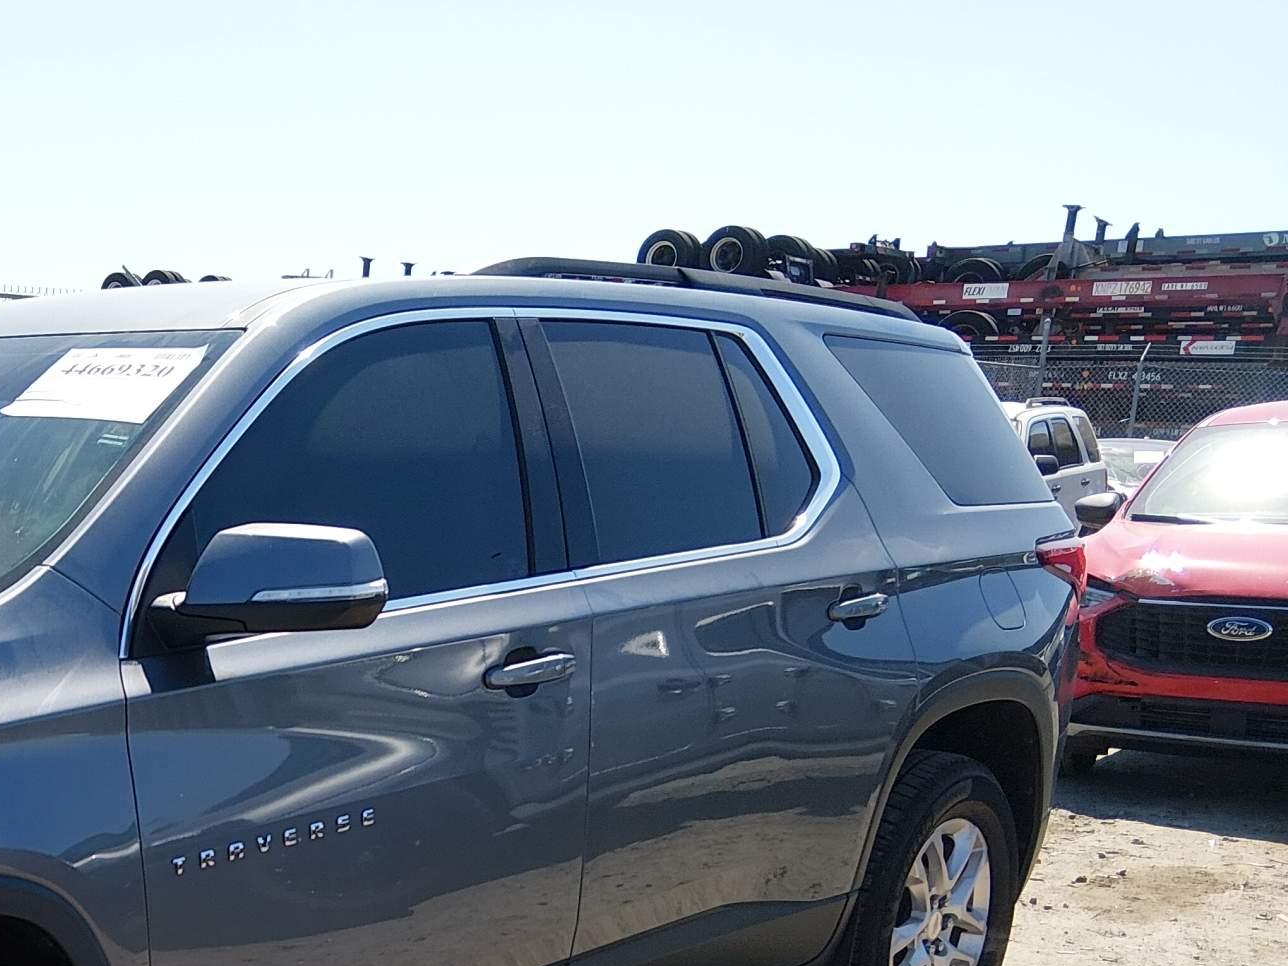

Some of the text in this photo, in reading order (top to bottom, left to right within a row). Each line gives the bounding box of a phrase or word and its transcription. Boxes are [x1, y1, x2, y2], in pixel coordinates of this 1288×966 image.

[60, 363, 176, 377] 44669320
[1108, 371, 1161, 382] FLXZ 43456
[1221, 621, 1257, 636] Ford
[172, 808, 376, 876] TRAVERSE
